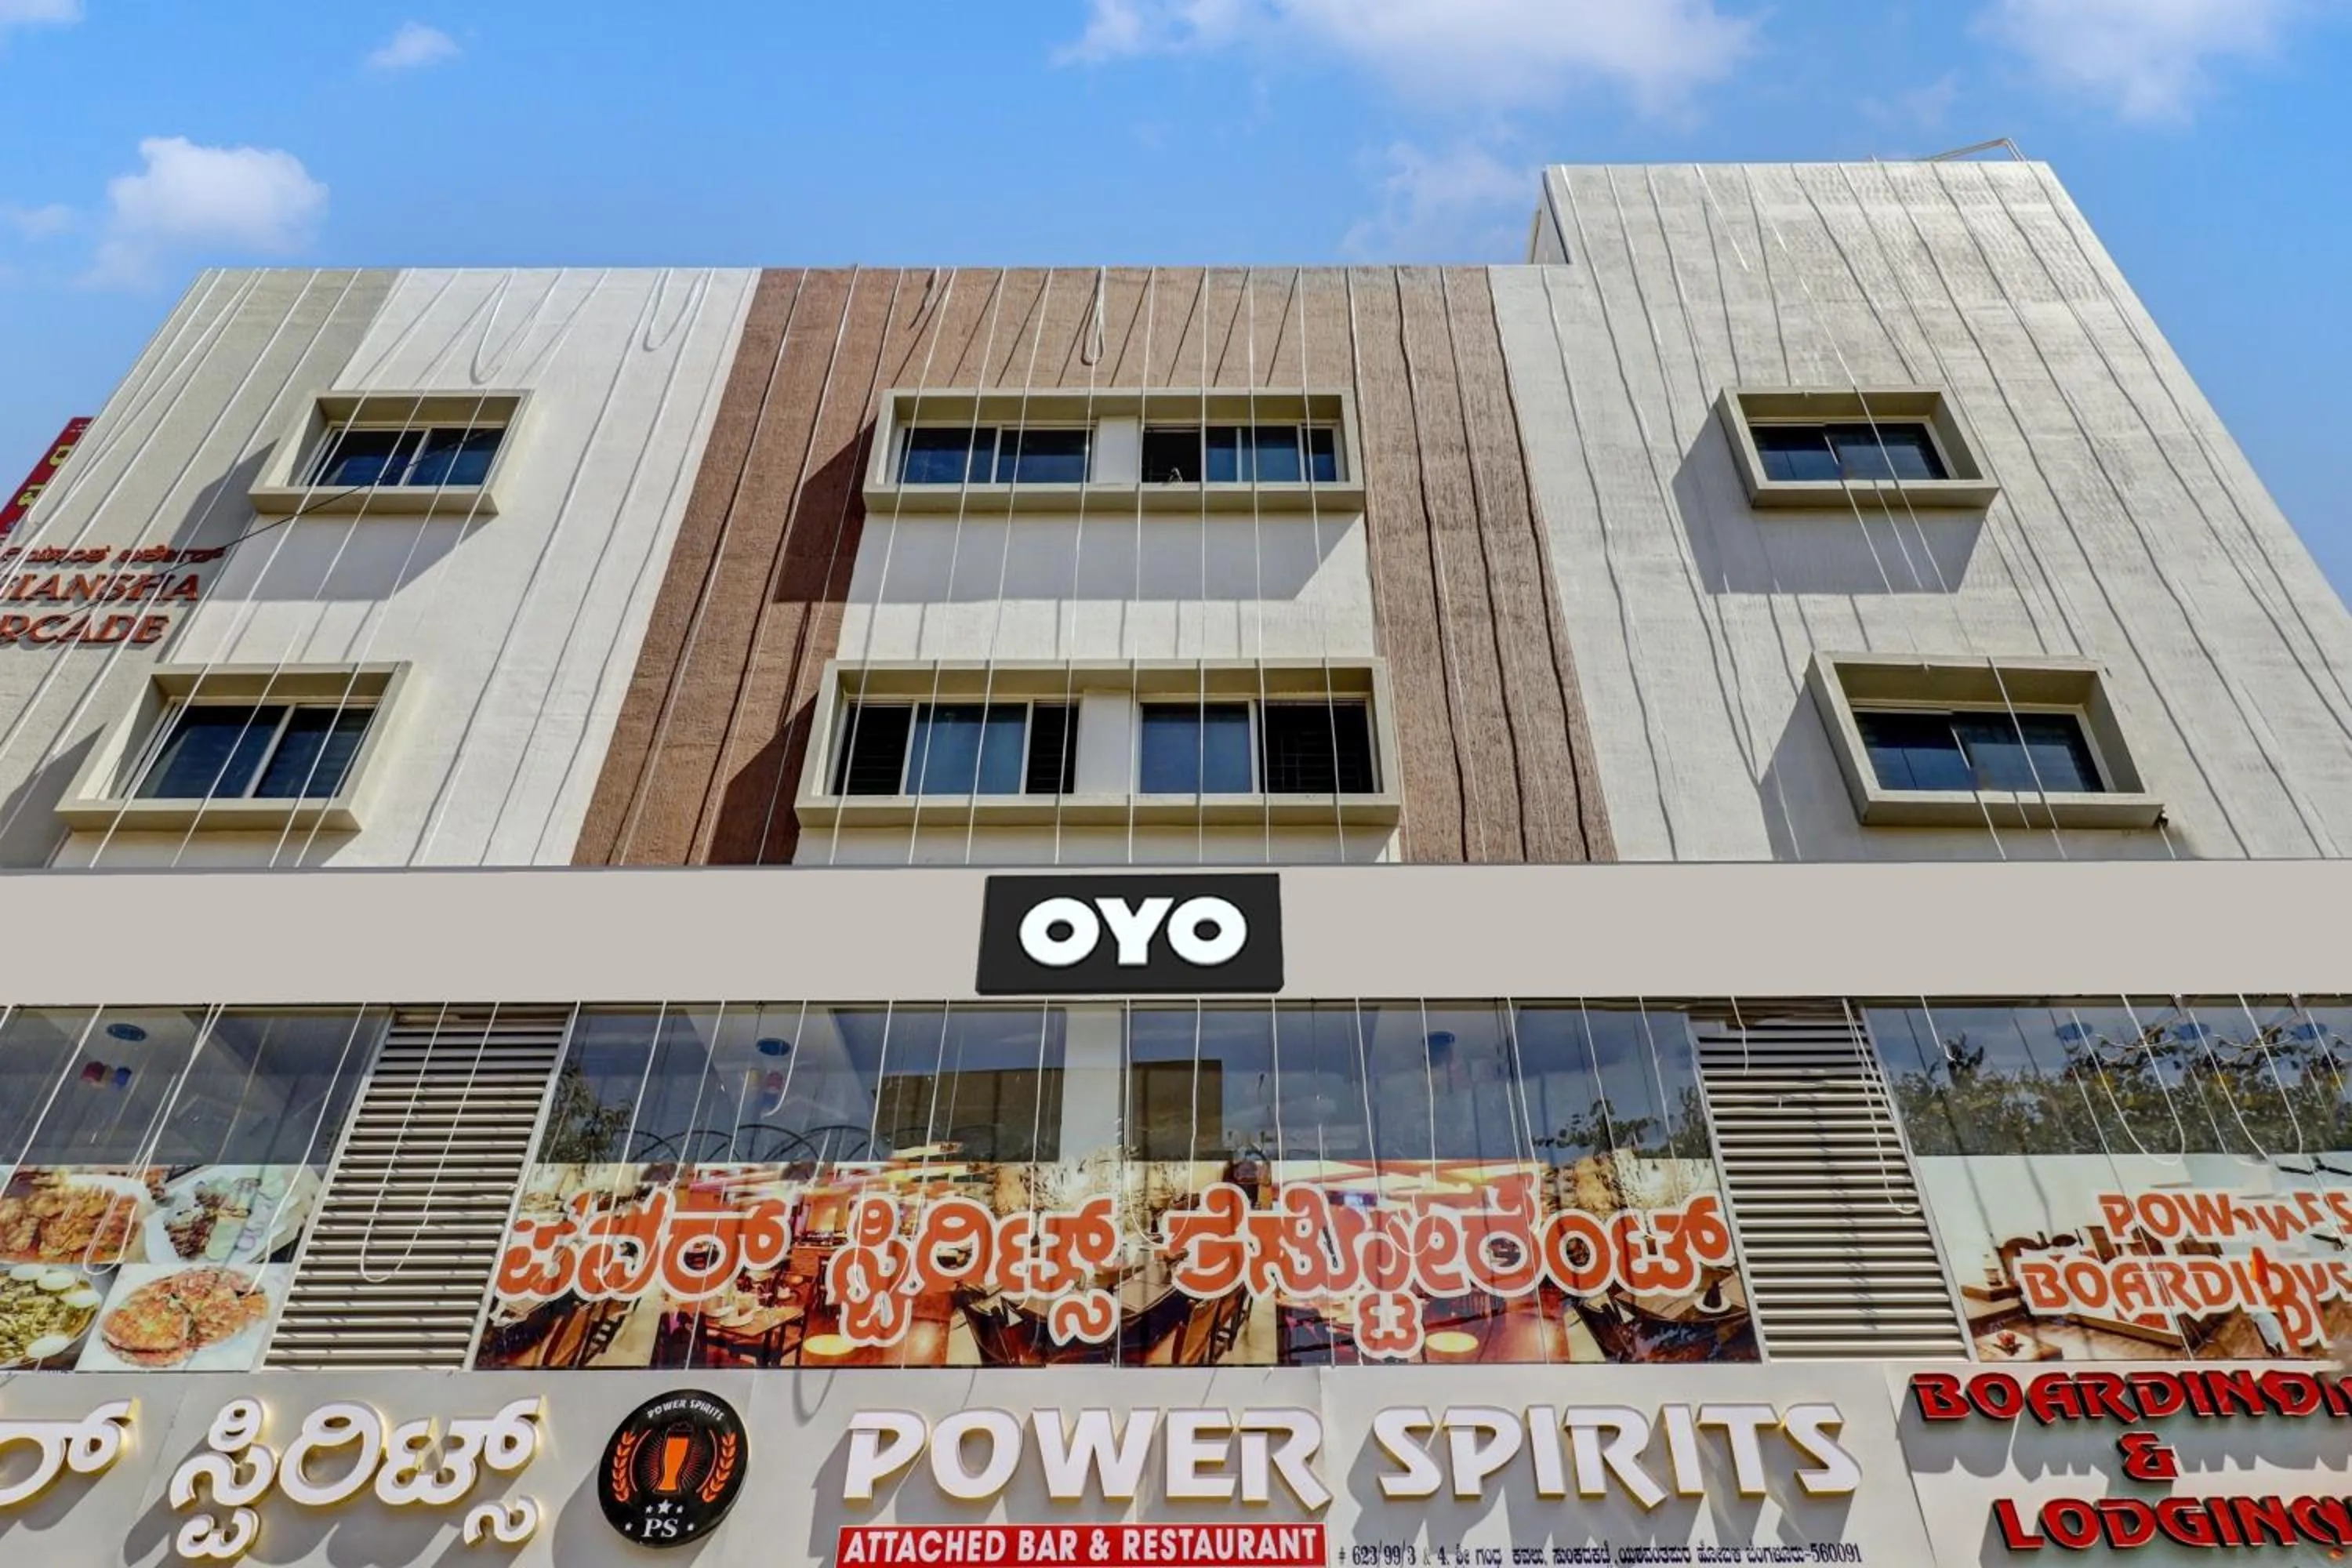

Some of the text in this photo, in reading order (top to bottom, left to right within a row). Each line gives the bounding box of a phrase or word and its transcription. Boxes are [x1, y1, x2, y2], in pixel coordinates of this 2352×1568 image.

[1019, 896, 1248, 966] OYO
[647, 1399, 725, 1421] POWER SPIRITS
[843, 1403, 1863, 1512] POWER SPIRITS
[2118, 1432, 2180, 1481] &
[641, 1518, 678, 1537] PS
[843, 1526, 1317, 1563] ATTACHED BAR & RESTAURANT
[1352, 1541, 1416, 1566] 623/99/3
